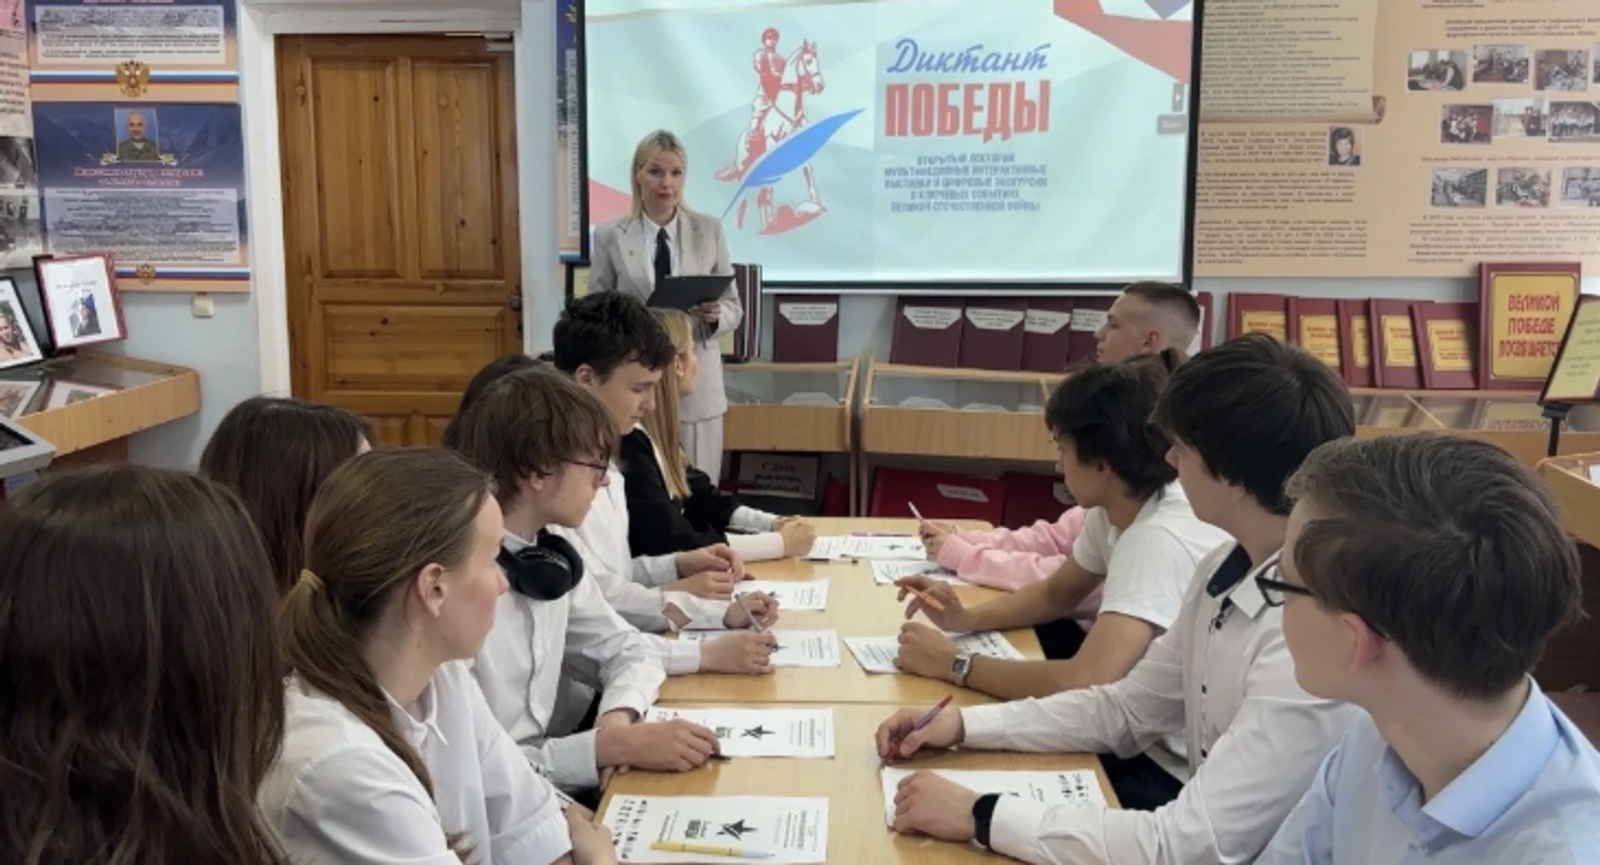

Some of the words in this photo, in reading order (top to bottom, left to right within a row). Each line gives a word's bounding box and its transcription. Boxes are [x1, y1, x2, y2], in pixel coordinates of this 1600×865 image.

[886, 38, 1052, 74] Диктант
[884, 80, 1051, 144] ПОБЕДЫ
[1508, 291, 1560, 312] ВЕЛИКОЙ
[1508, 317, 1555, 334] ПОБЕДЕ
